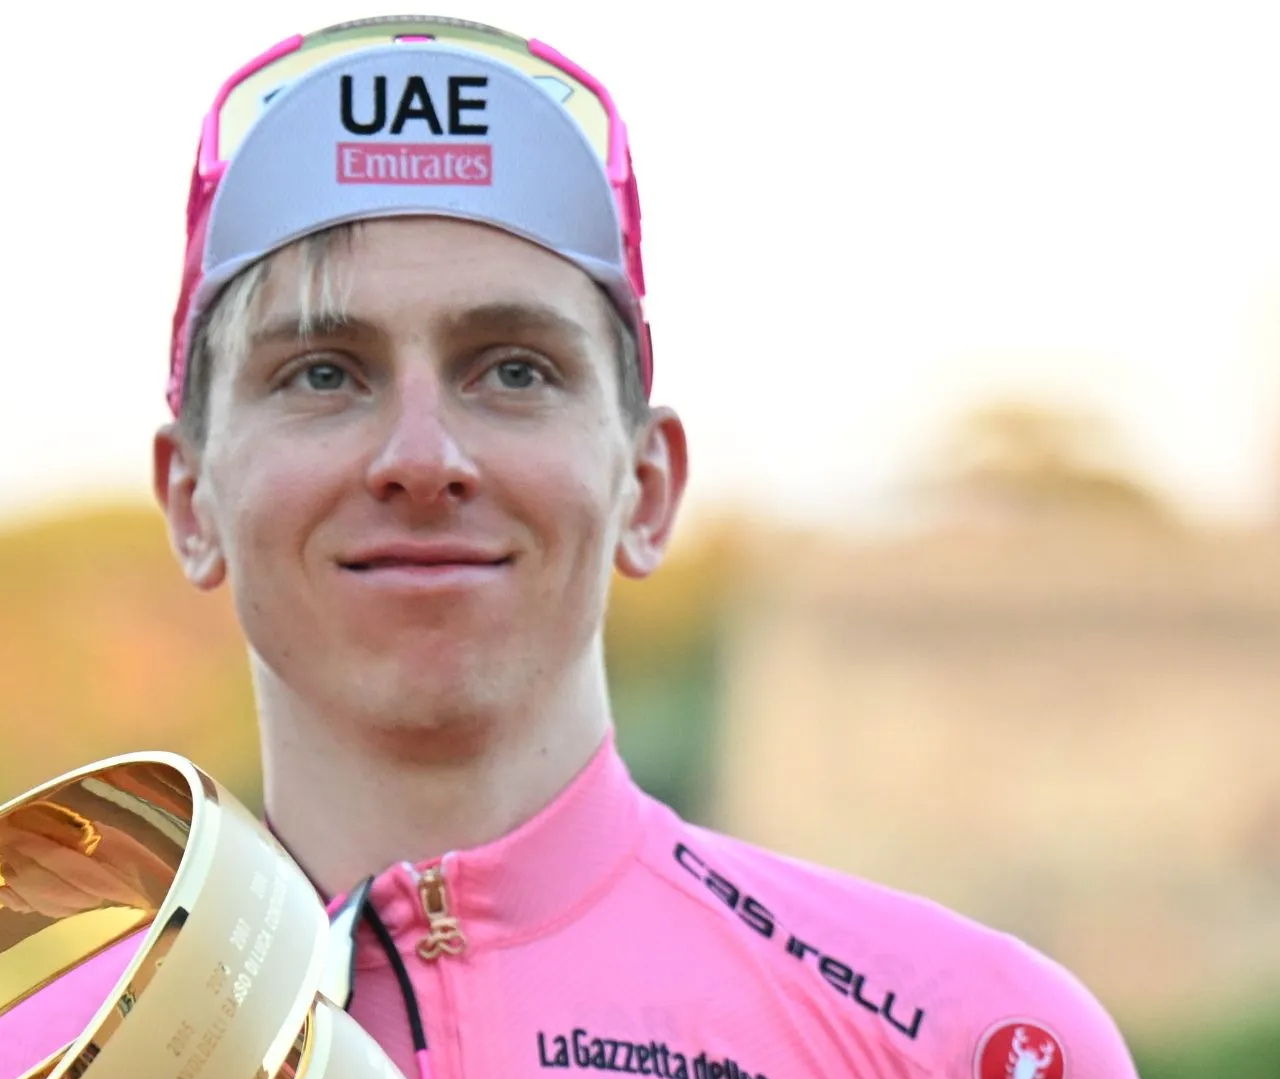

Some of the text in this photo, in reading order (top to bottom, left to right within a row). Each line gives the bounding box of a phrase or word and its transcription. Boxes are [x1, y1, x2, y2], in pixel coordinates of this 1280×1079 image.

[340, 75, 488, 136] UAE
[341, 148, 488, 181] Emirates
[537, 1031, 569, 1068] La
